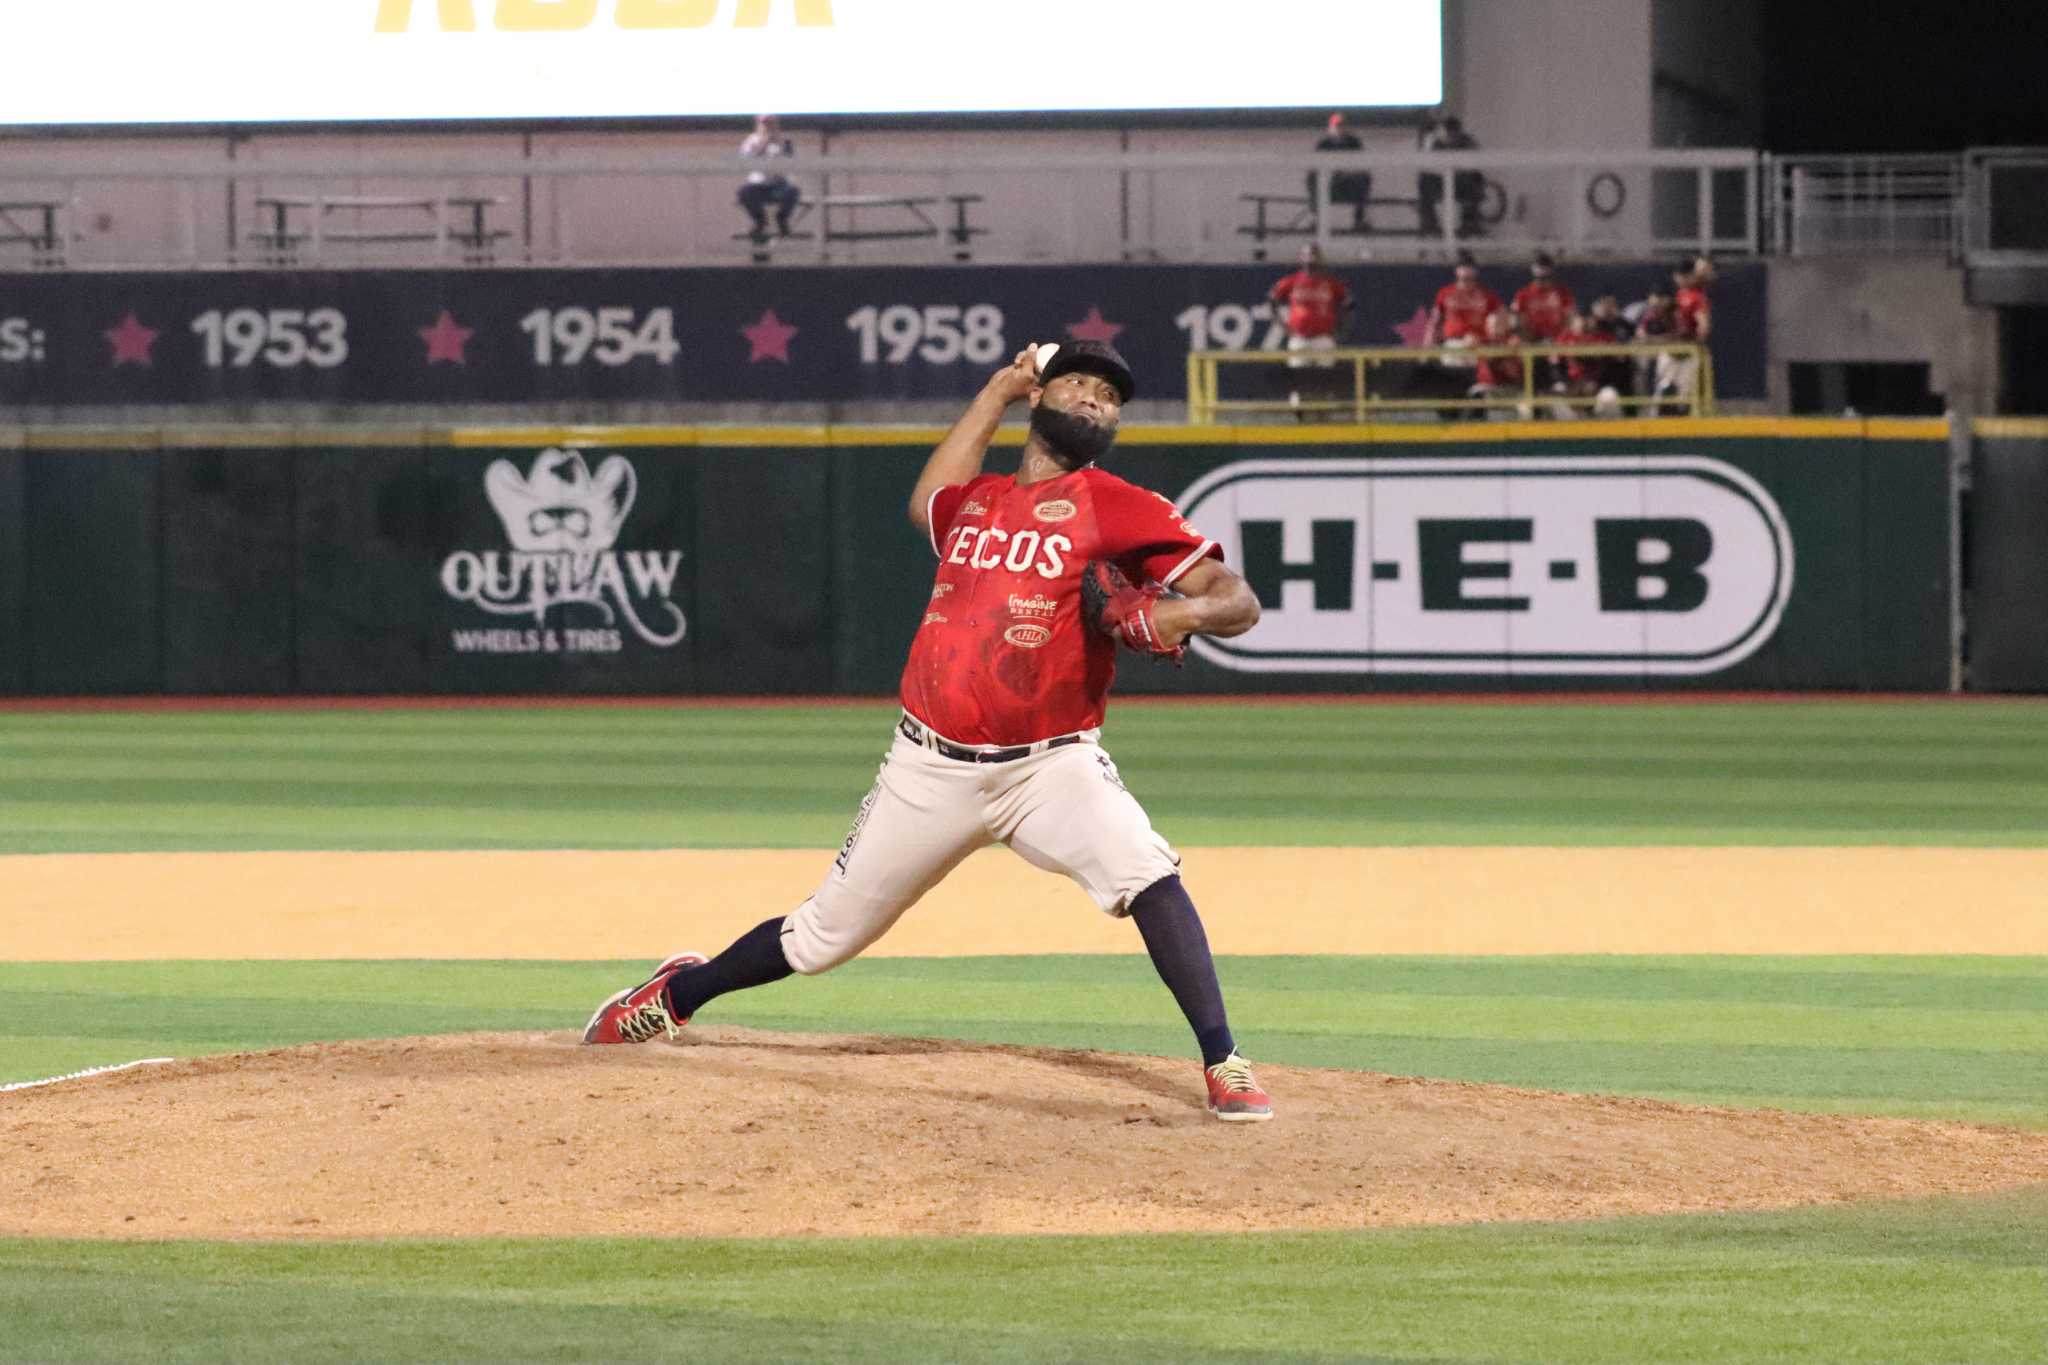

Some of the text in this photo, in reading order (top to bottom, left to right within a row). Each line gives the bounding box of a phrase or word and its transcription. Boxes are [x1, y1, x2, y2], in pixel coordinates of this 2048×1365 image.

[191, 308, 348, 368] 1953
[520, 307, 681, 366] 1954
[847, 304, 1005, 364] 1958
[1175, 304, 1291, 351] 197
[441, 549, 687, 648] OUTLAW
[1240, 517, 1714, 612] H-E-B
[452, 628, 622, 653] WHEELS & TIRES
